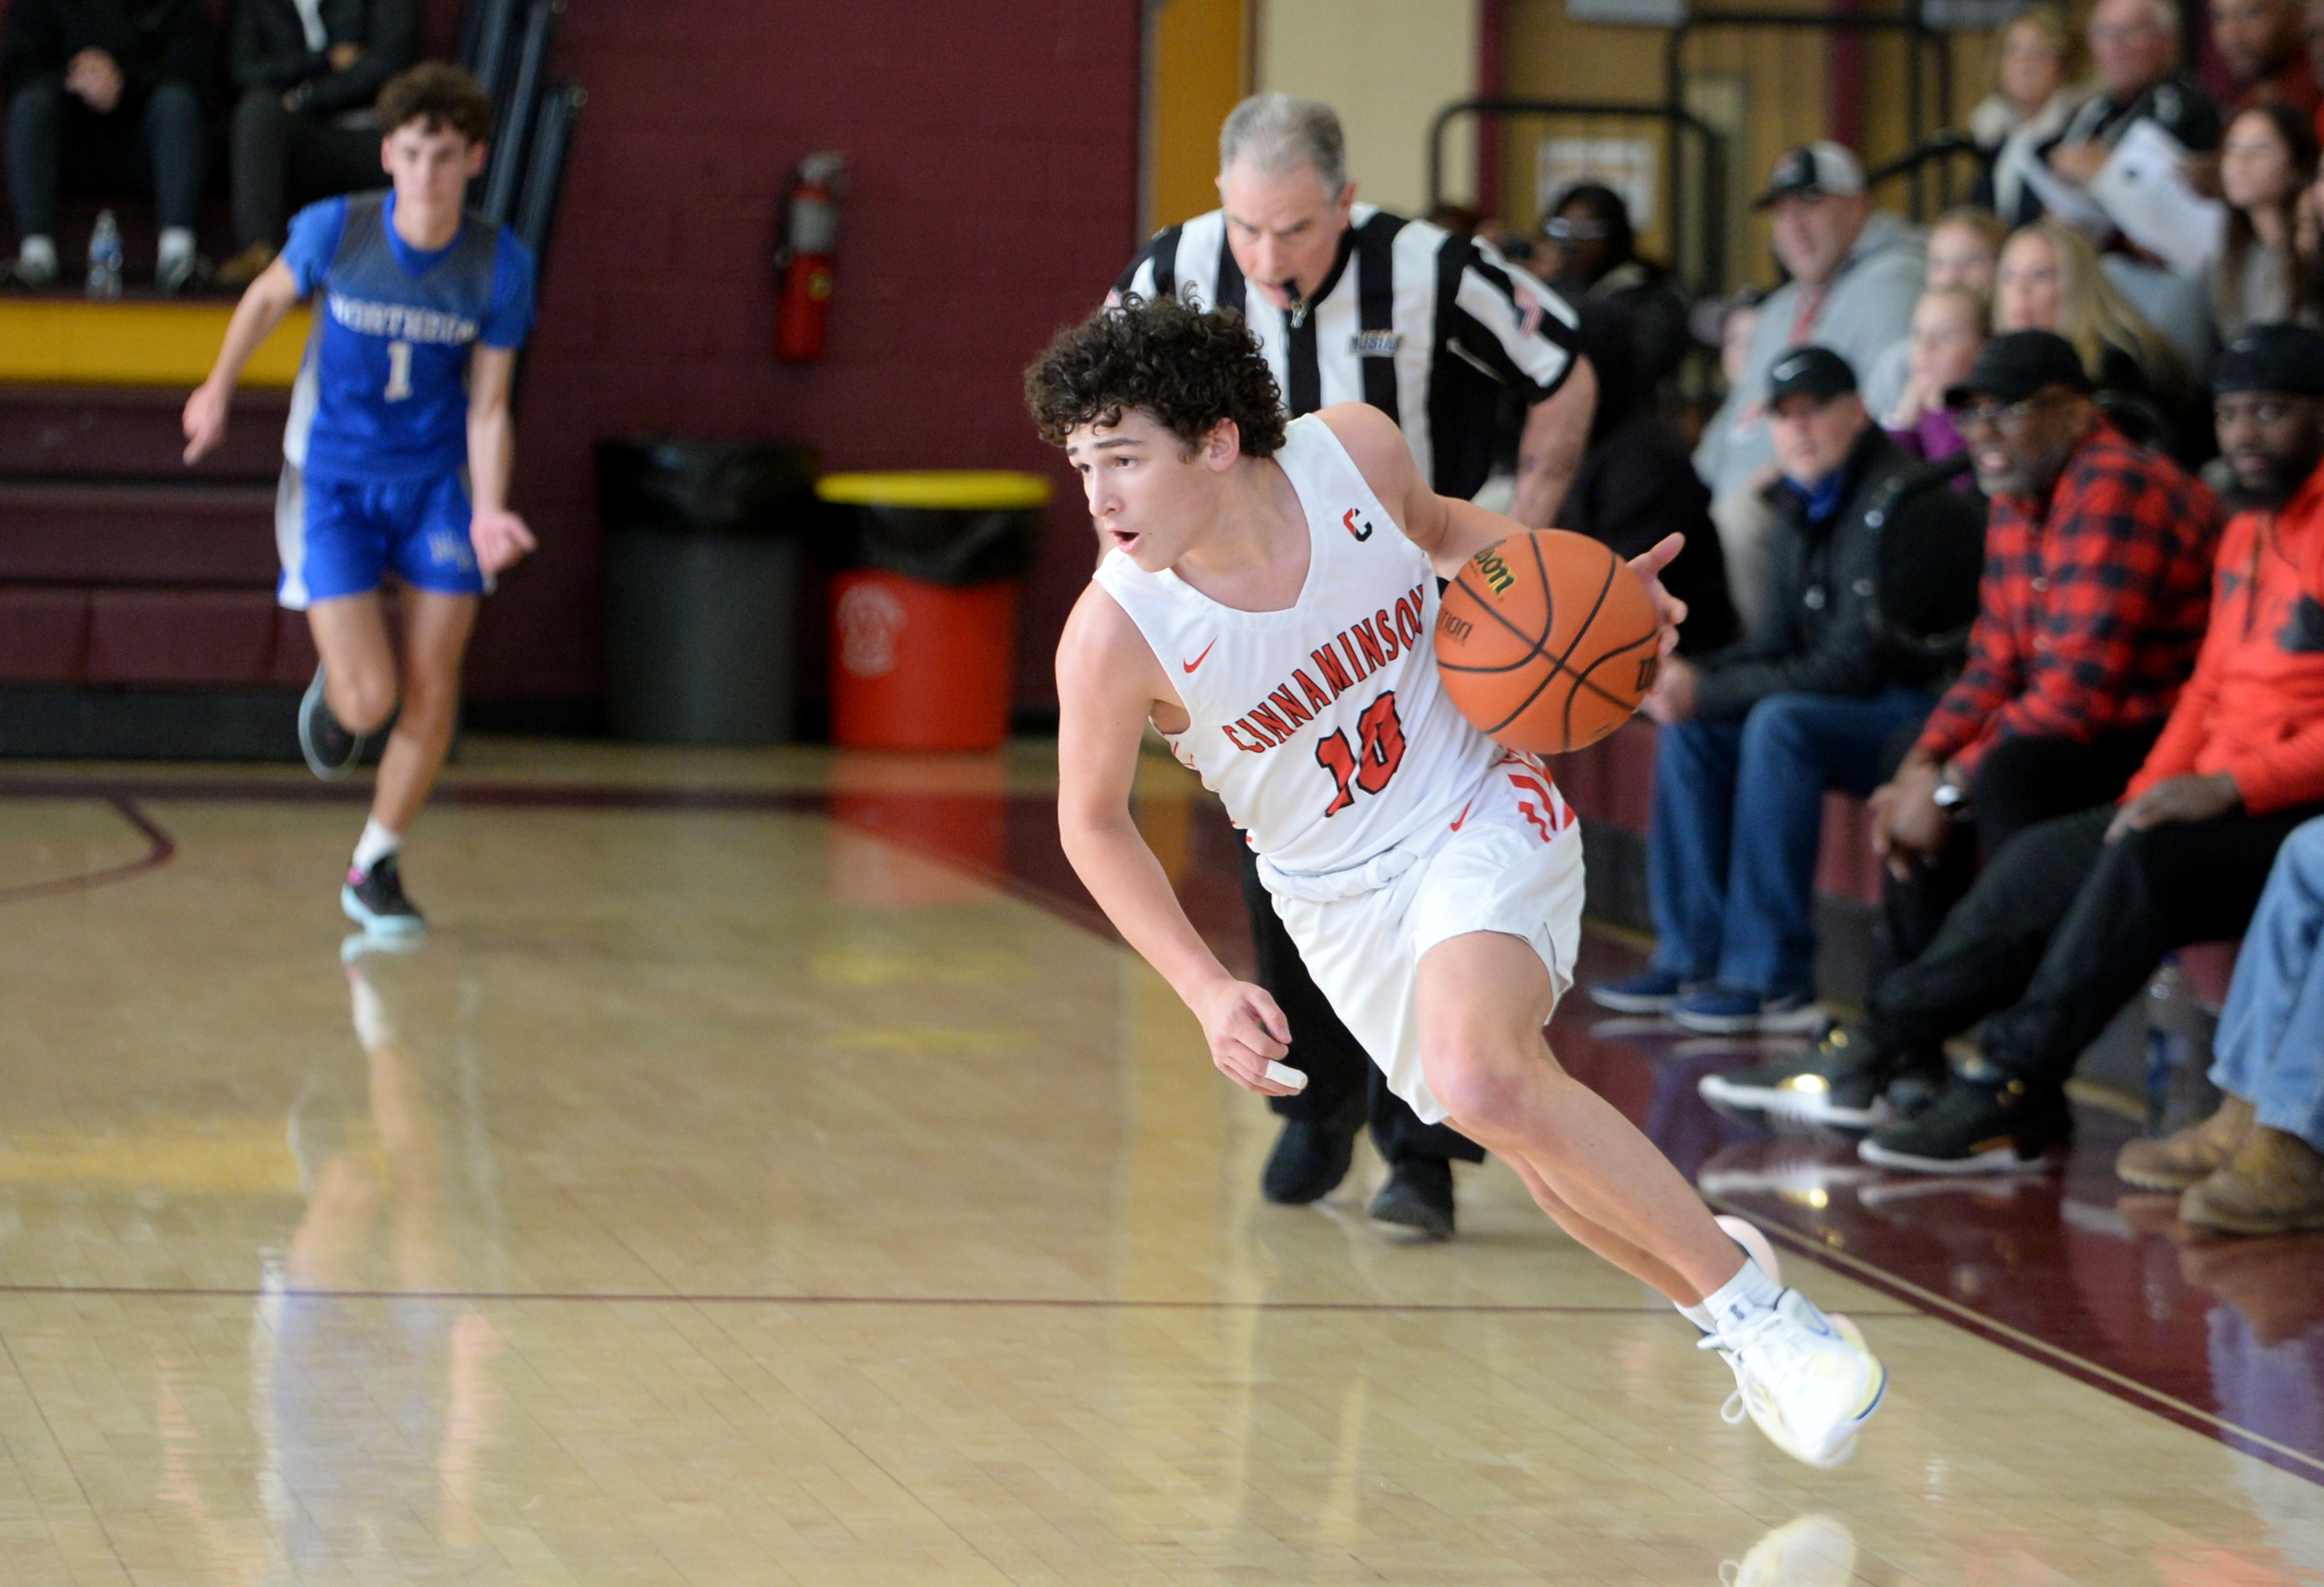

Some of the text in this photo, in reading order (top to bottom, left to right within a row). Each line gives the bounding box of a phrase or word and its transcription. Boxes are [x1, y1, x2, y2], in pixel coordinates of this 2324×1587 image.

[385, 342, 413, 402] 1
[1343, 507, 1372, 542] C
[1222, 584, 1423, 753] CINNAMINSON
[1314, 690, 1406, 817] 10
